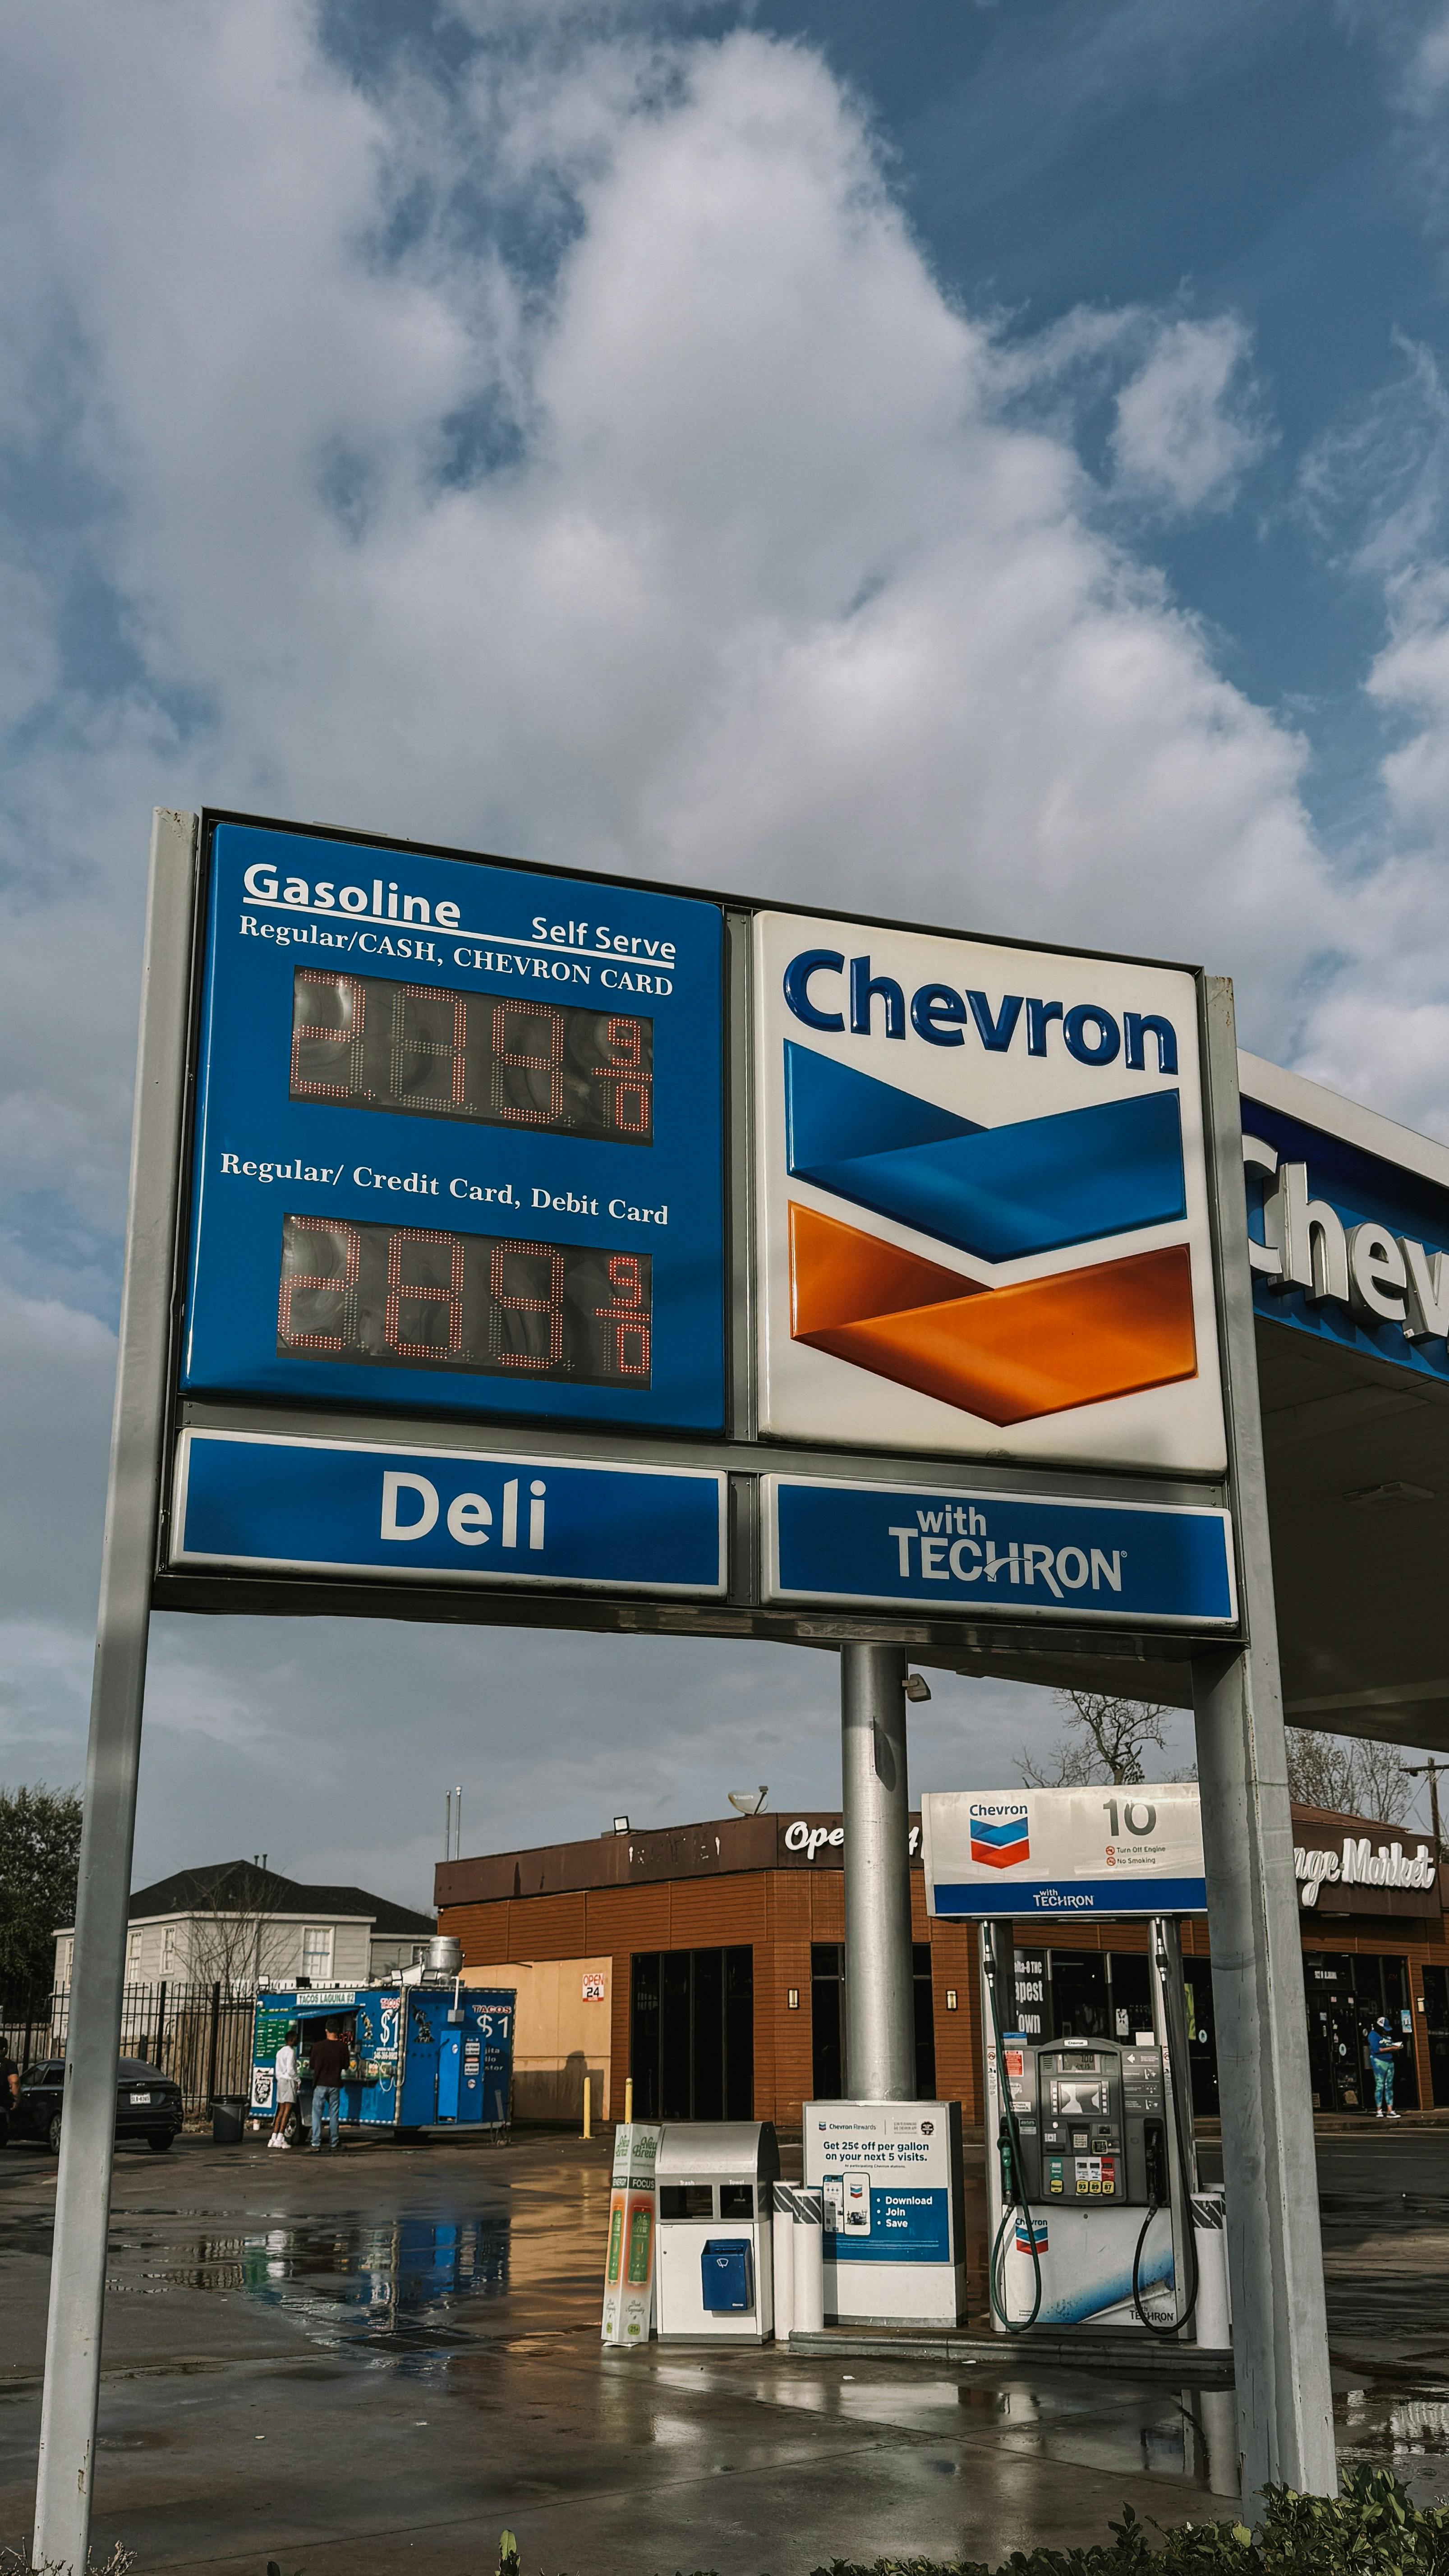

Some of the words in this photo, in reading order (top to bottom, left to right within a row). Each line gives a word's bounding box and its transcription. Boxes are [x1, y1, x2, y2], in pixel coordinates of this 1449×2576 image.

[244, 863, 460, 927] Gasoline
[532, 917, 588, 945] Self
[596, 927, 676, 960] Serve
[239, 915, 443, 966] Regular/CASH,
[454, 948, 591, 984] CHEVRON
[601, 969, 673, 996] CARD
[783, 949, 1178, 1075] Chevron
[221, 1153, 344, 1185] Regular/
[353, 1167, 439, 1195] Credit
[450, 1178, 520, 1209] Card,
[531, 1188, 599, 1215] Debit
[608, 1199, 668, 1225] Card
[380, 1471, 547, 1550] Deli
[916, 1504, 986, 1536] with
[970, 1804, 1028, 1816] Chevron
[1103, 1799, 1156, 1836] 10
[785, 1821, 844, 1860] Ope
[1294, 1847, 1340, 1906] age
[1342, 1838, 1435, 1888] Market
[1033, 1895, 1094, 1908] TECHRON
[584, 1974, 603, 1986] OPEN
[299, 1994, 318, 2003] TACOS
[586, 1987, 599, 1997] 24
[1015, 1981, 1044, 2003] apest
[472, 2005, 512, 2013] TACOS
[477, 2014, 508, 2038] $1
[1017, 2010, 1041, 2033] own
[823, 2142, 839, 2150] Get
[842, 2142, 859, 2151] 25¢
[861, 2142, 875, 2150] off
[878, 2143, 894, 2153] per
[897, 2142, 929, 2152] gallon
[840, 2153, 861, 2162] your
[864, 2153, 885, 2161] next
[898, 2152, 927, 2161] visits.
[633, 2179, 654, 2188] FOCUS
[885, 2196, 933, 2205] Download
[885, 2208, 906, 2216] Join
[886, 2219, 908, 2227] Save
[1129, 2310, 1174, 2323] TEHRON
